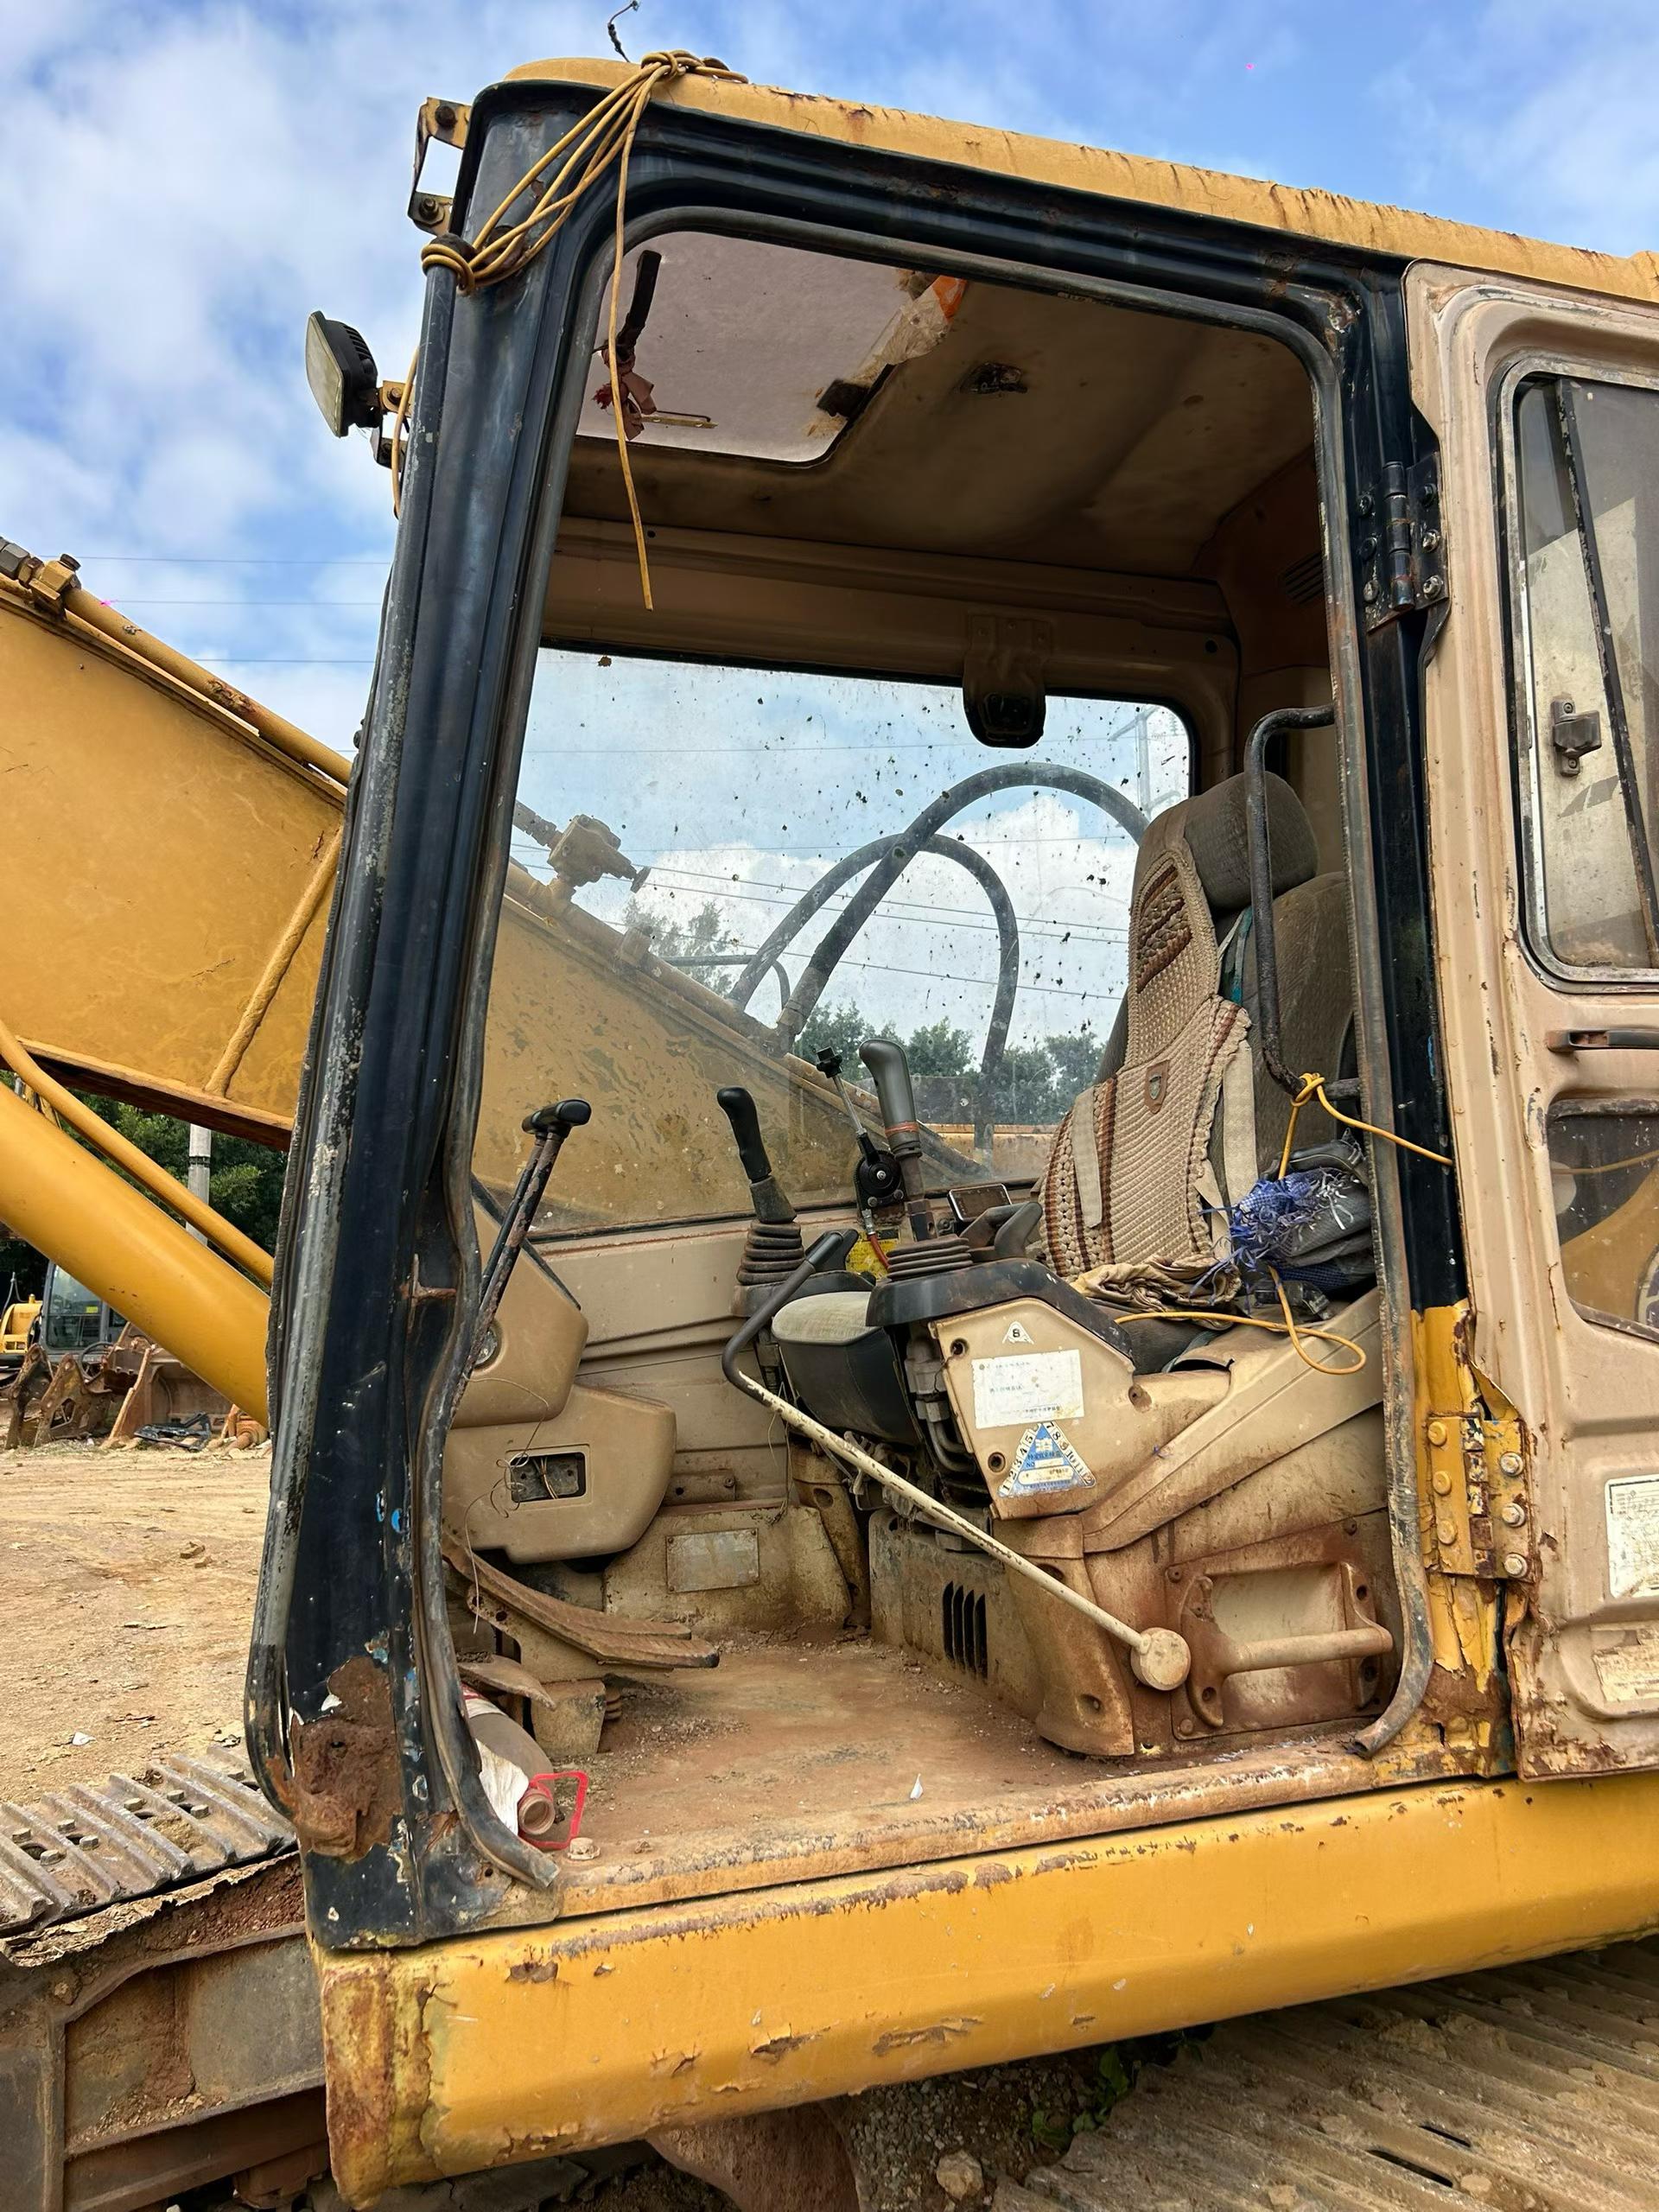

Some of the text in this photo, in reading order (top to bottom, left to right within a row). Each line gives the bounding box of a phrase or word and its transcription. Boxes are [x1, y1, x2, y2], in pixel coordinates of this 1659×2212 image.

[1008, 1471, 1017, 1480] 2
[1014, 1459, 1022, 1469] 3
[1020, 1447, 1028, 1456] 4
[1025, 1435, 1033, 1444] 5
[1052, 1432, 1061, 1440] 8
[1065, 1451, 1076, 1463] 10
